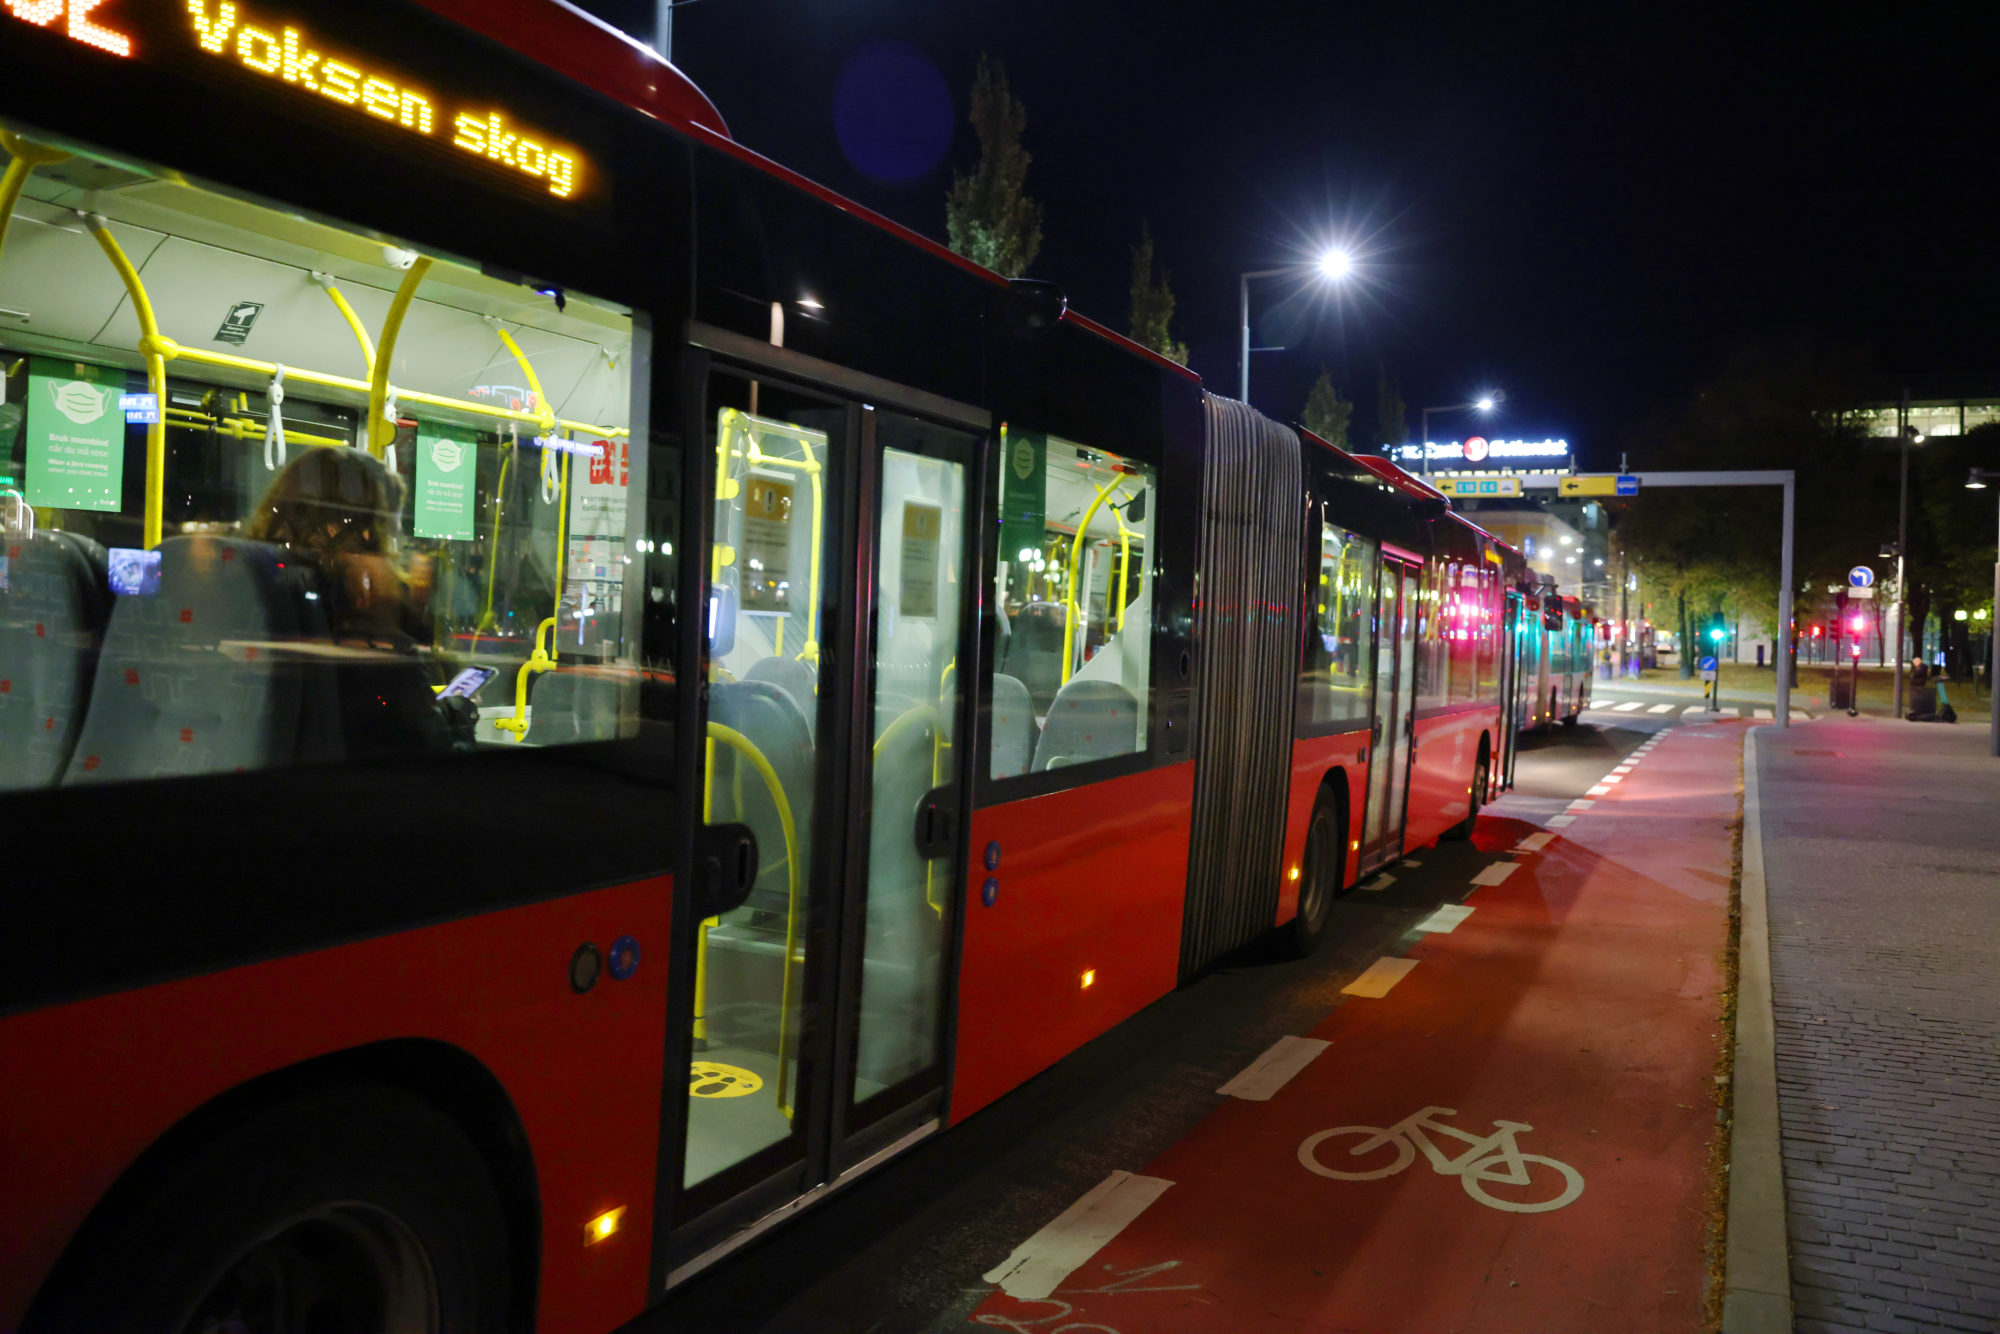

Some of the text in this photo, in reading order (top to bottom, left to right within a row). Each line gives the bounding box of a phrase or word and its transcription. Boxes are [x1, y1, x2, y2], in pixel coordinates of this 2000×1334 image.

[188, 0, 432, 134] Voksen
[453, 111, 573, 197] skog
[49, 433, 69, 442] Bruk
